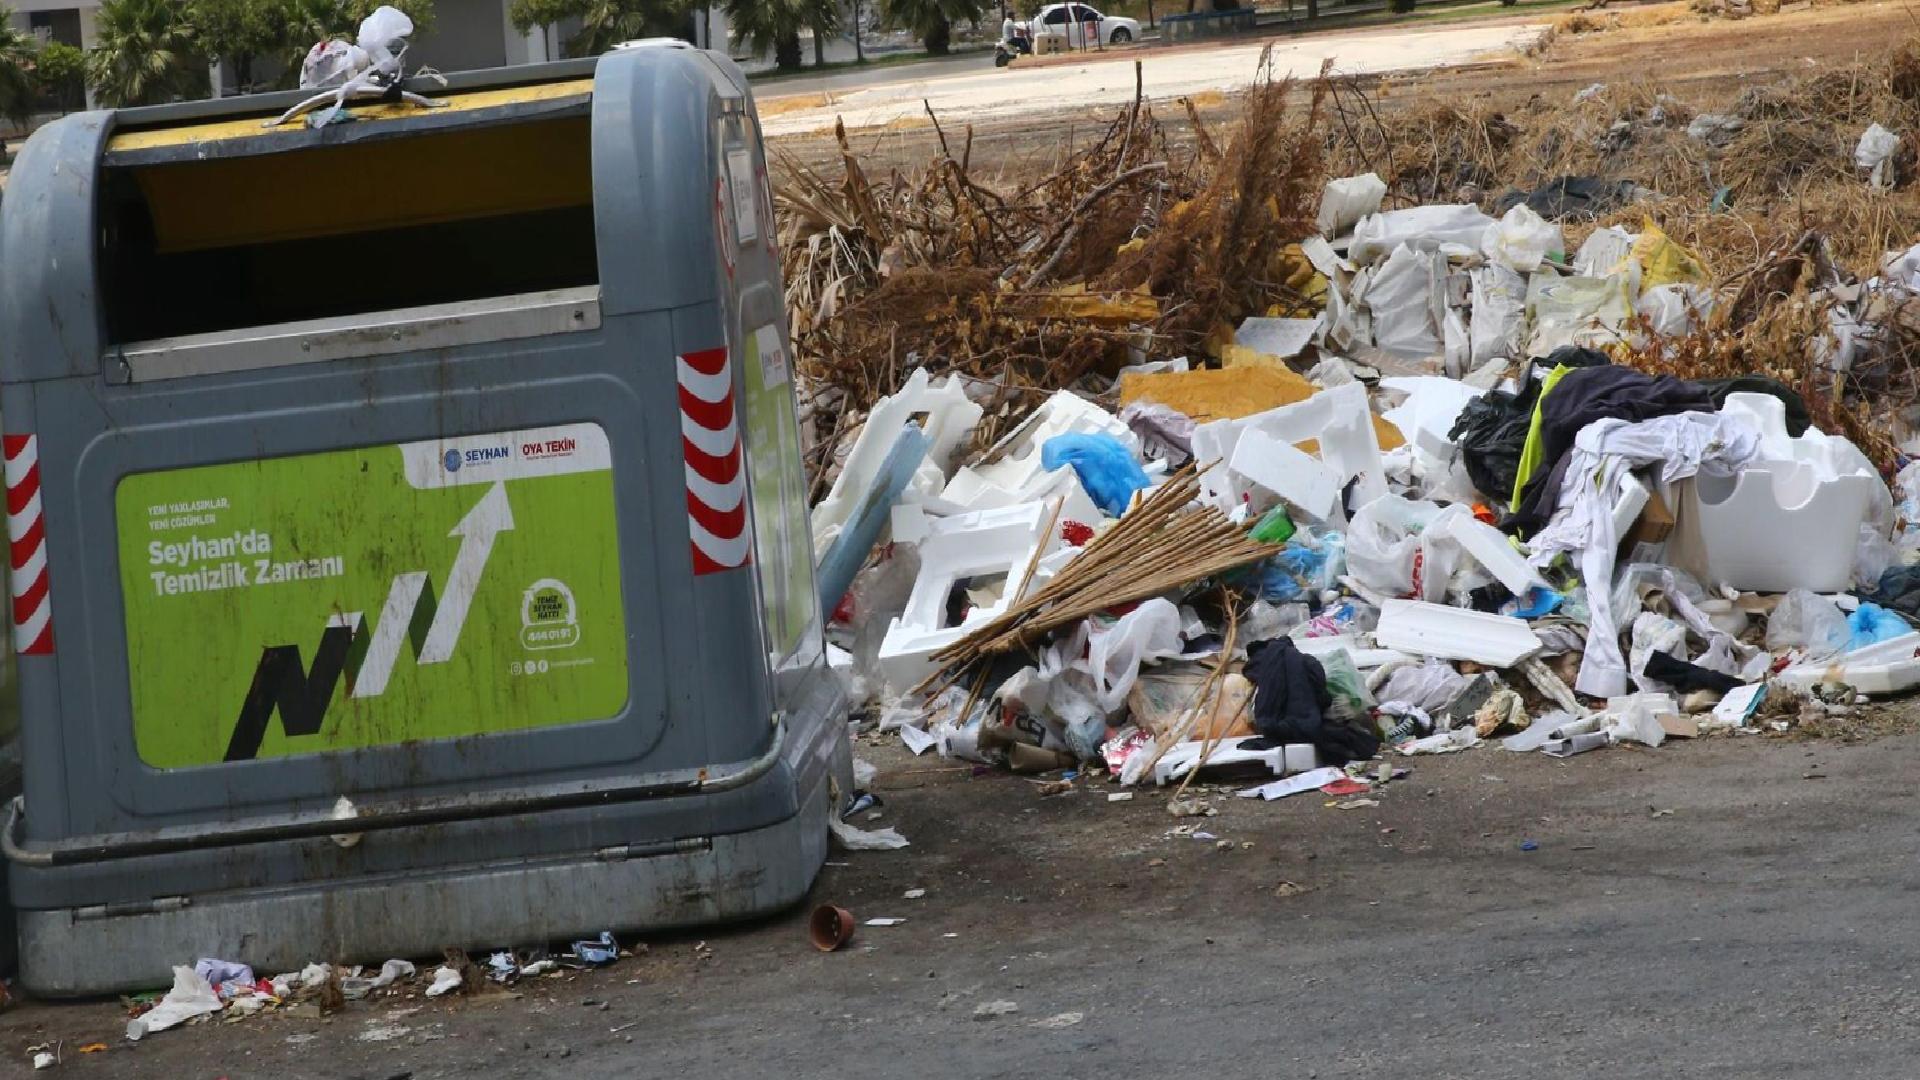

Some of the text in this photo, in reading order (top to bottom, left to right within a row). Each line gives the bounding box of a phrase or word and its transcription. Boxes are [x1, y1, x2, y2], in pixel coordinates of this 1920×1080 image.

[465, 447, 509, 462] SEYHAN
[522, 437, 576, 456] OYA TEKİN
[151, 555, 344, 596] Temizlik Zamanı
